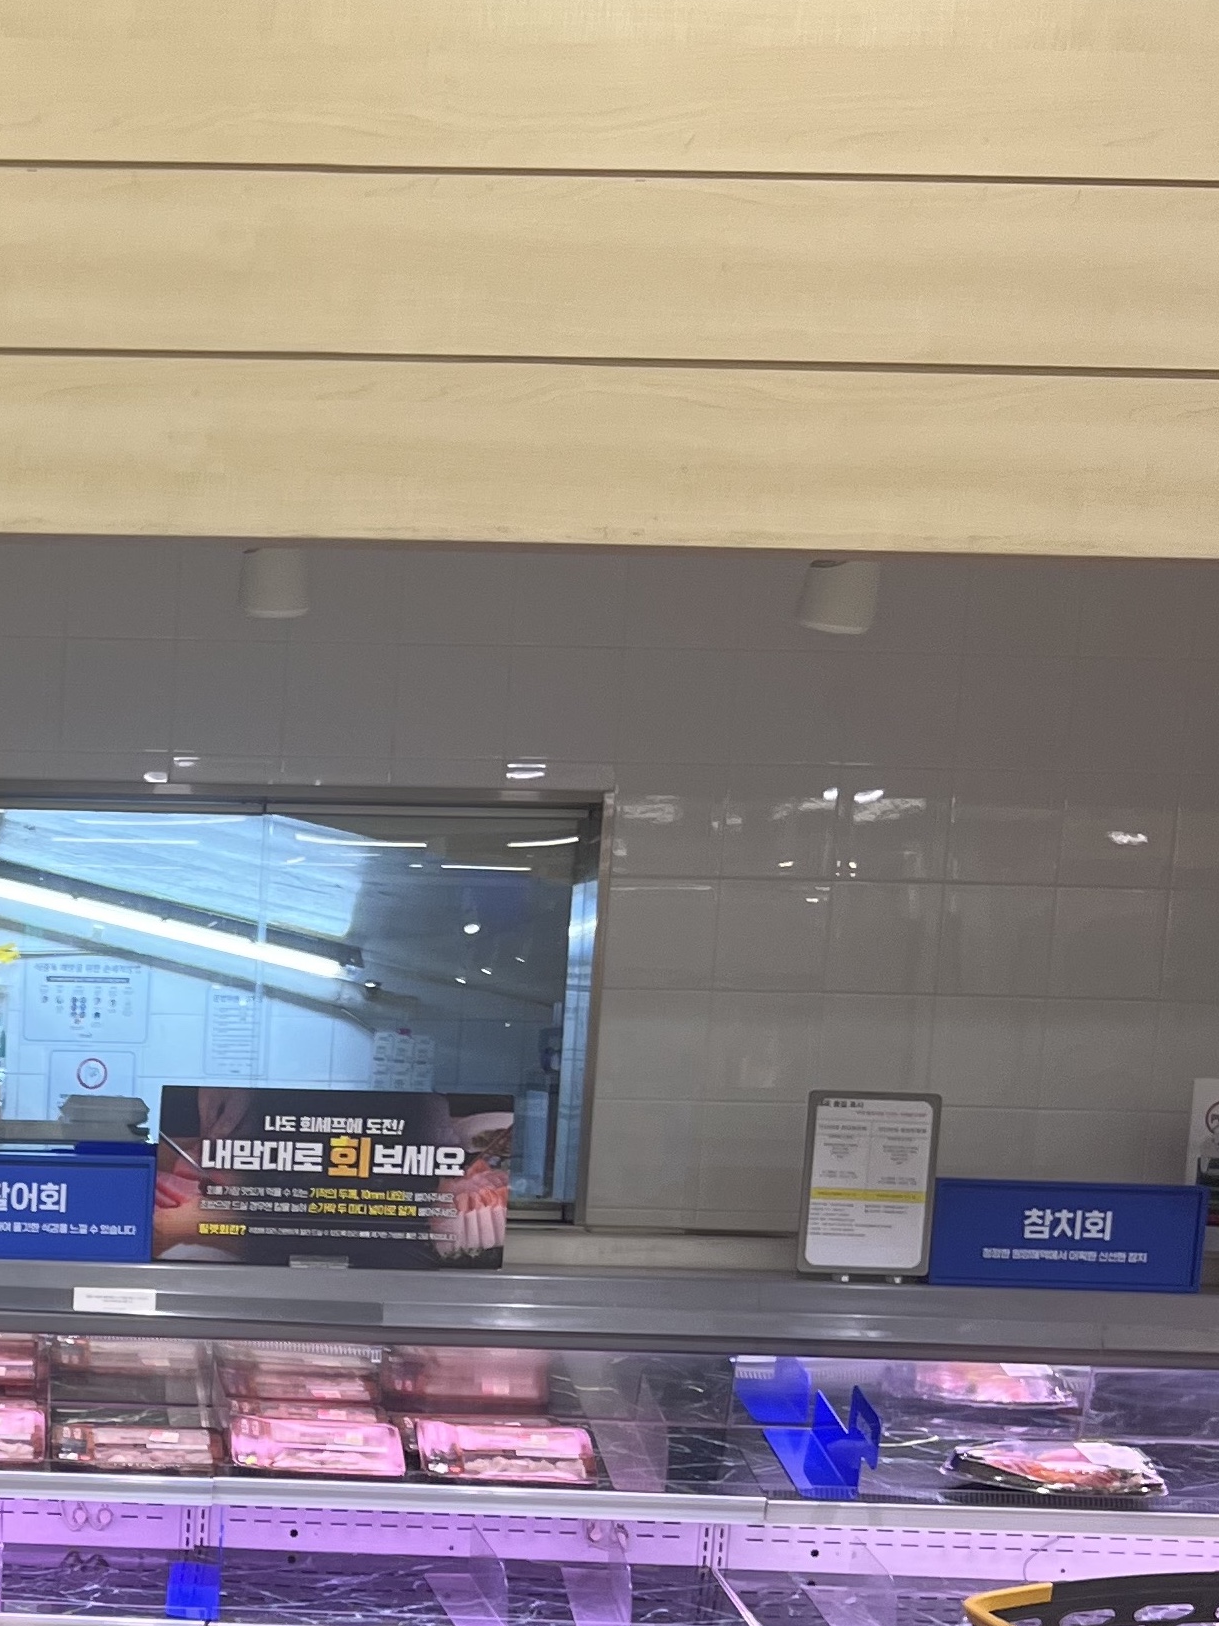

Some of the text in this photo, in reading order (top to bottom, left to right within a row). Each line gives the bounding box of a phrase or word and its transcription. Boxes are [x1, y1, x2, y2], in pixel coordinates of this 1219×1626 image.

[264, 1115, 297, 1133] 나도
[366, 1118, 406, 1136] 도전!
[201, 1139, 324, 1173] 내맘대로
[283, 1187, 291, 1198] 수
[337, 1203, 347, 1214] 두
[348, 1203, 367, 1215] 마디
[89, 1223, 99, 1235] 수
[99, 1224, 137, 1236] 있습니다
[1023, 1208, 1113, 1241] 참치회
